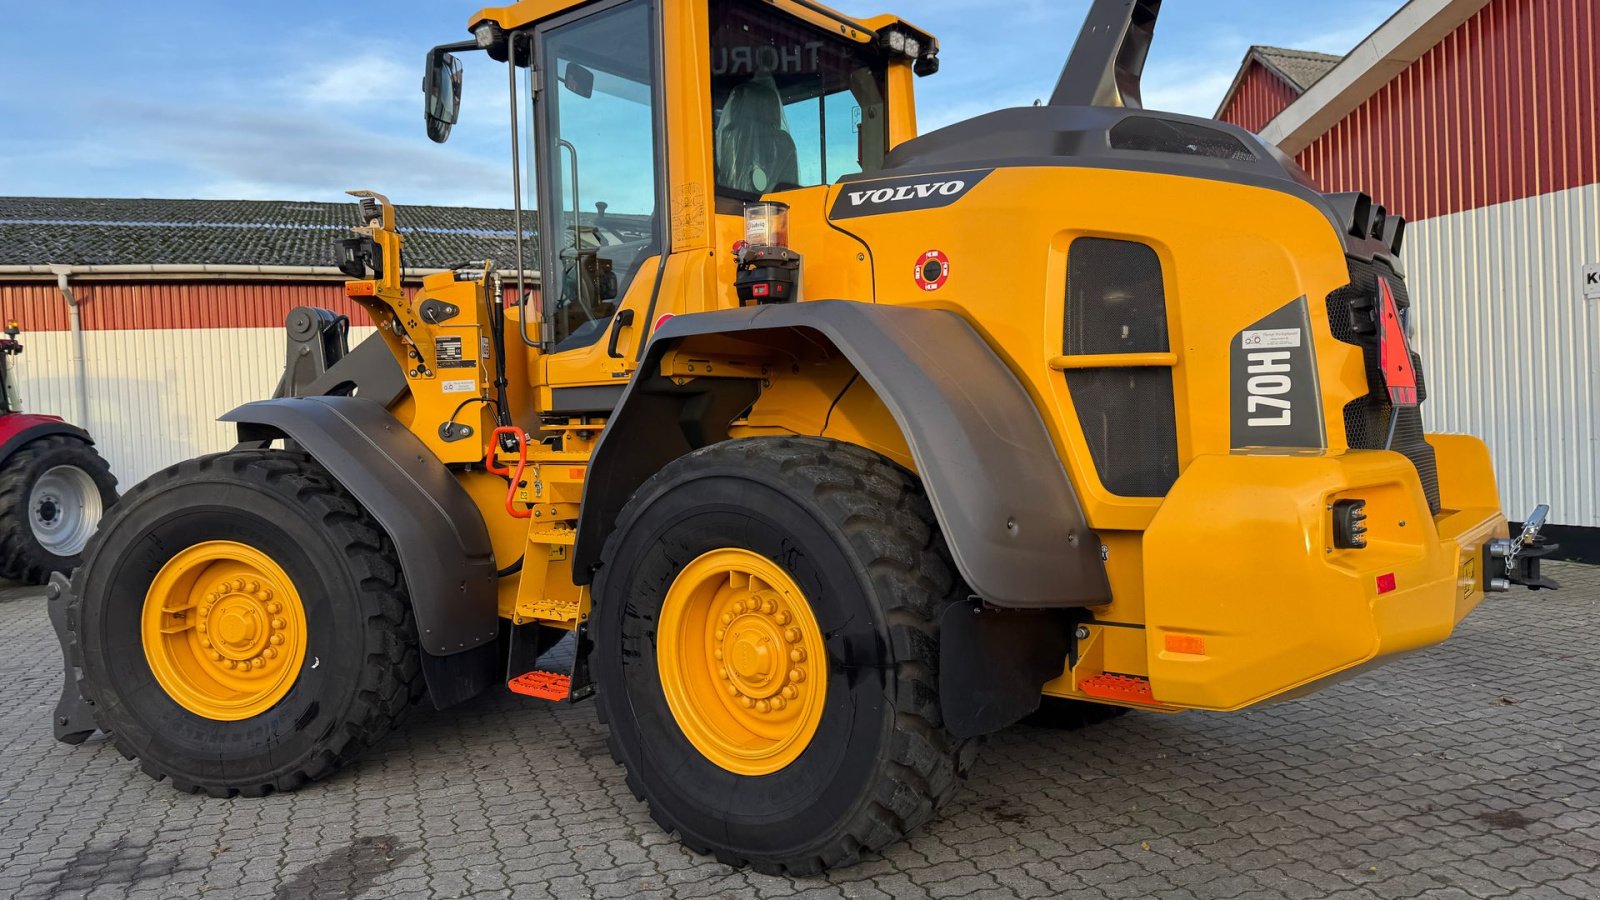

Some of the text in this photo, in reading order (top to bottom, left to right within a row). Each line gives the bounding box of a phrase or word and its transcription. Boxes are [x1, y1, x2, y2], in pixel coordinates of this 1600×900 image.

[848, 180, 965, 206] VOLVO
[1587, 272, 1600, 284] K
[1247, 351, 1291, 426] L70H
